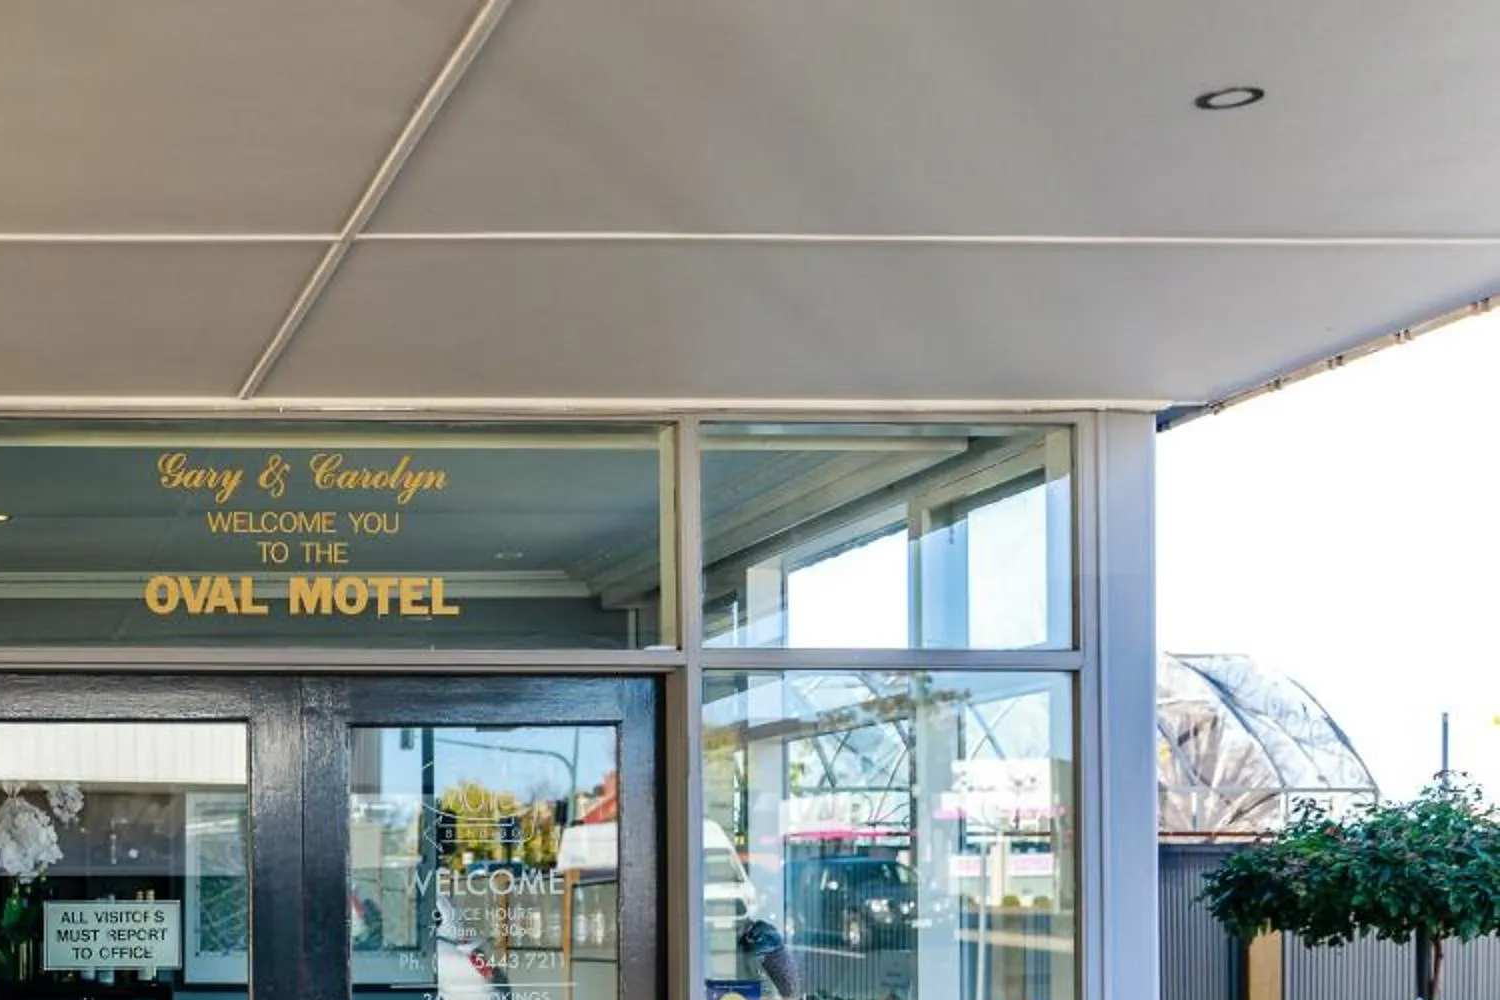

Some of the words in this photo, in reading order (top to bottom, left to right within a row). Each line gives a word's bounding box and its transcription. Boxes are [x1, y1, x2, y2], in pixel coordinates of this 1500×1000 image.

[156, 452, 243, 503] Gary
[258, 454, 291, 497] &
[310, 452, 449, 504] Carolyn
[206, 511, 336, 534] WELCOME
[348, 511, 400, 534] YOU
[257, 541, 289, 564] TO
[303, 541, 349, 564] THE
[144, 575, 269, 616] OVAL
[288, 575, 460, 616] MOTEL
[61, 911, 88, 924] ALL
[57, 929, 100, 943] MUST
[107, 928, 169, 942] REPORT
[71, 946, 93, 960] TO
[99, 946, 153, 960] OFFICE
